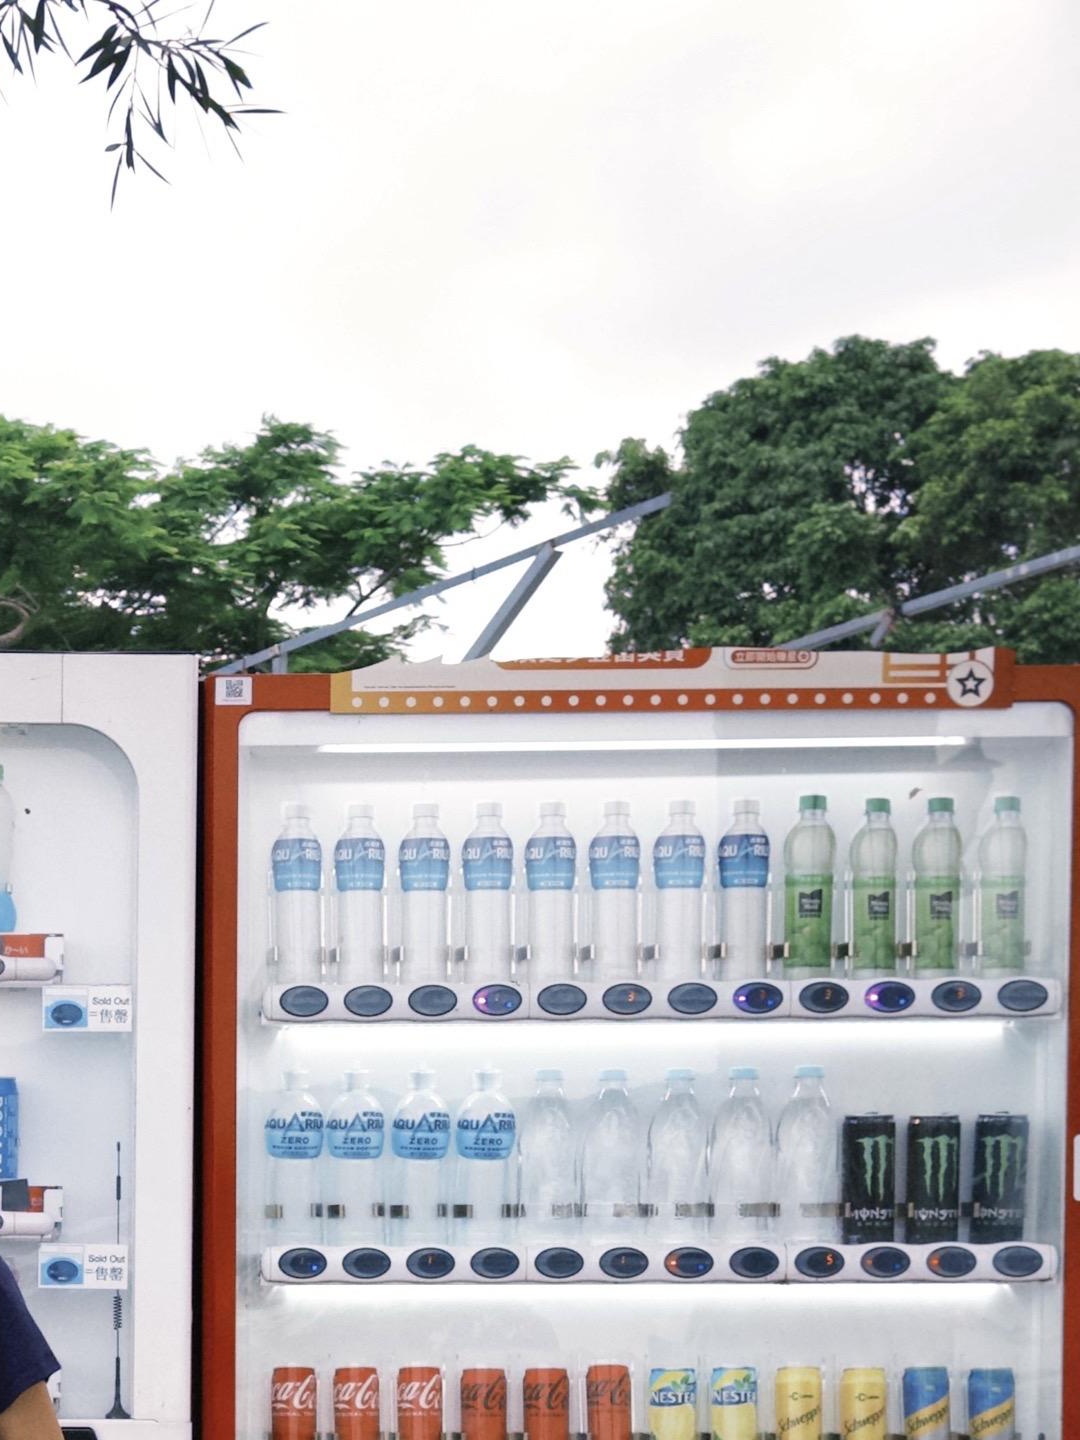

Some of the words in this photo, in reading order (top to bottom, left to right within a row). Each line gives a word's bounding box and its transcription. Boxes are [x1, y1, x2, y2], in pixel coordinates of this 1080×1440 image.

[92, 997, 112, 1006] Sold
[114, 997, 130, 1006] Out
[280, 1136, 310, 1145] ZERO
[342, 1136, 372, 1145] ZERO
[409, 1137, 439, 1146] ZERO
[473, 1137, 503, 1146] ZERO
[88, 1255, 107, 1263] Sold
[109, 1255, 125, 1263] Out
[777, 1406, 821, 1433] Schwepp
[843, 1406, 886, 1435] Schwepp
